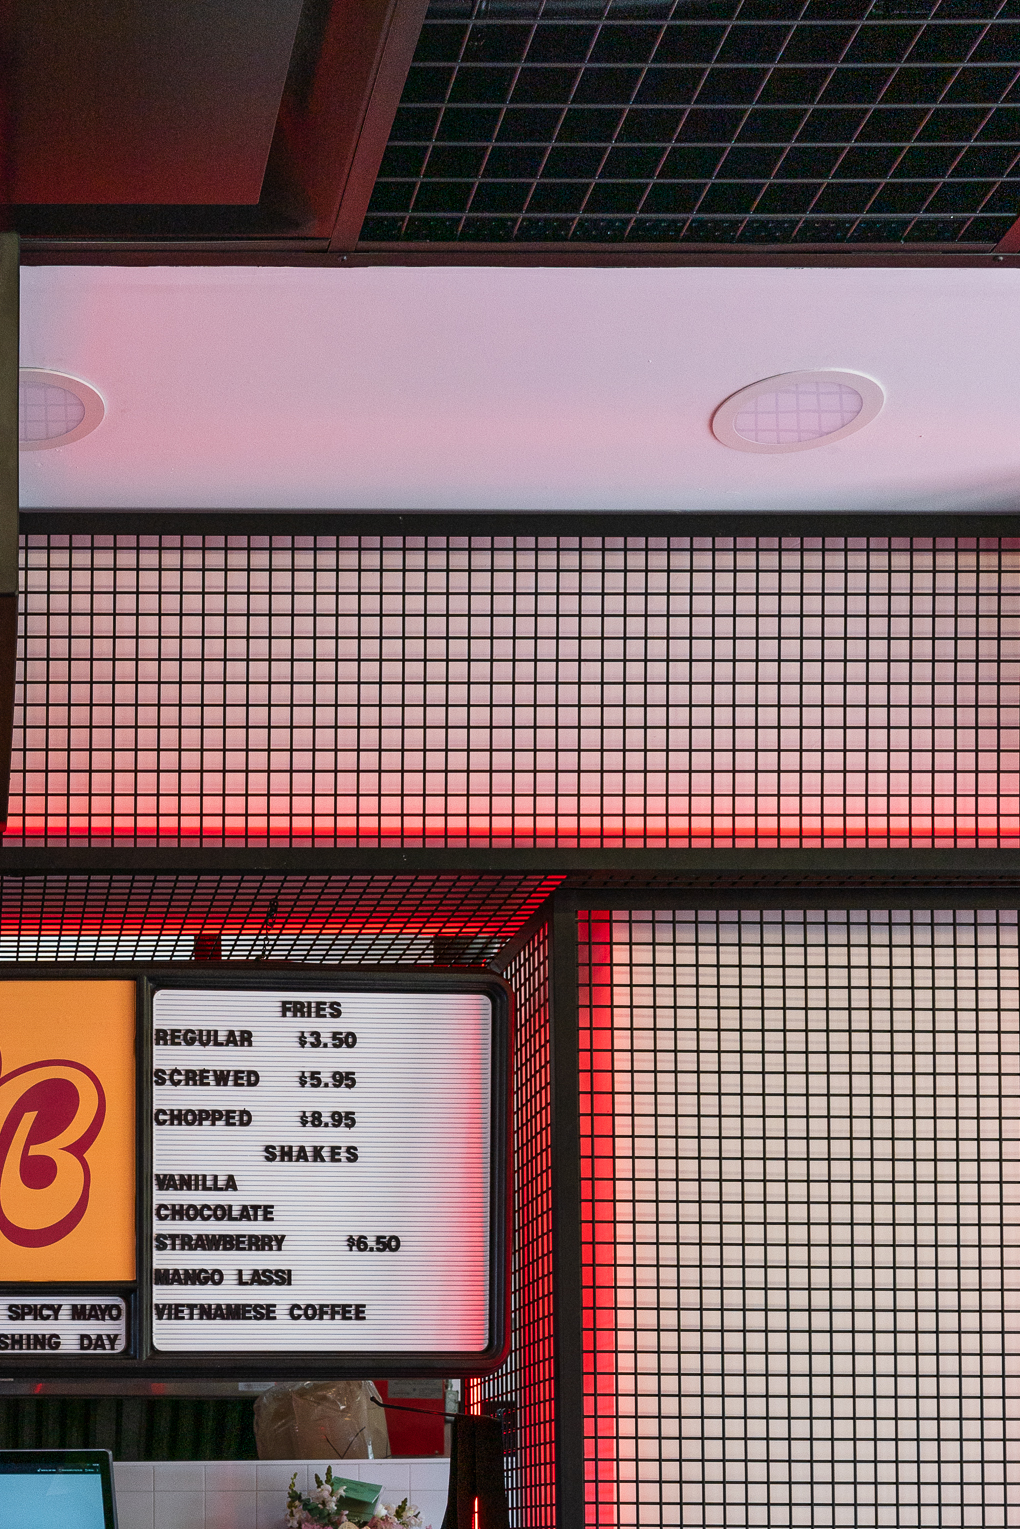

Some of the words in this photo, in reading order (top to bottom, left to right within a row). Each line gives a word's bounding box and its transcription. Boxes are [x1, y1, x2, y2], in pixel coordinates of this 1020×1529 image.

[281, 1000, 342, 1019] FRIES
[155, 1029, 253, 1048] REGULAR
[298, 1031, 357, 1049] $3.50
[154, 1069, 260, 1087] SCREWED
[298, 1070, 356, 1089] $5.95
[154, 1109, 252, 1127] CHOPPED
[300, 1110, 356, 1129] $8.95
[264, 1144, 359, 1163] SHAKES
[155, 1174, 238, 1192] VANILLA
[155, 1204, 275, 1222] CHOCOLATE
[155, 1234, 286, 1252] STRAWBERRY
[346, 1235, 401, 1252] $6.50
[154, 1268, 224, 1286] MANGO
[238, 1269, 292, 1286] LASSI
[7, 1304, 62, 1321] SPICY
[72, 1304, 122, 1322] MAYO
[155, 1303, 277, 1321] VIETNAMESE
[289, 1304, 366, 1321] COFFEE
[79, 1334, 119, 1351] DAY
